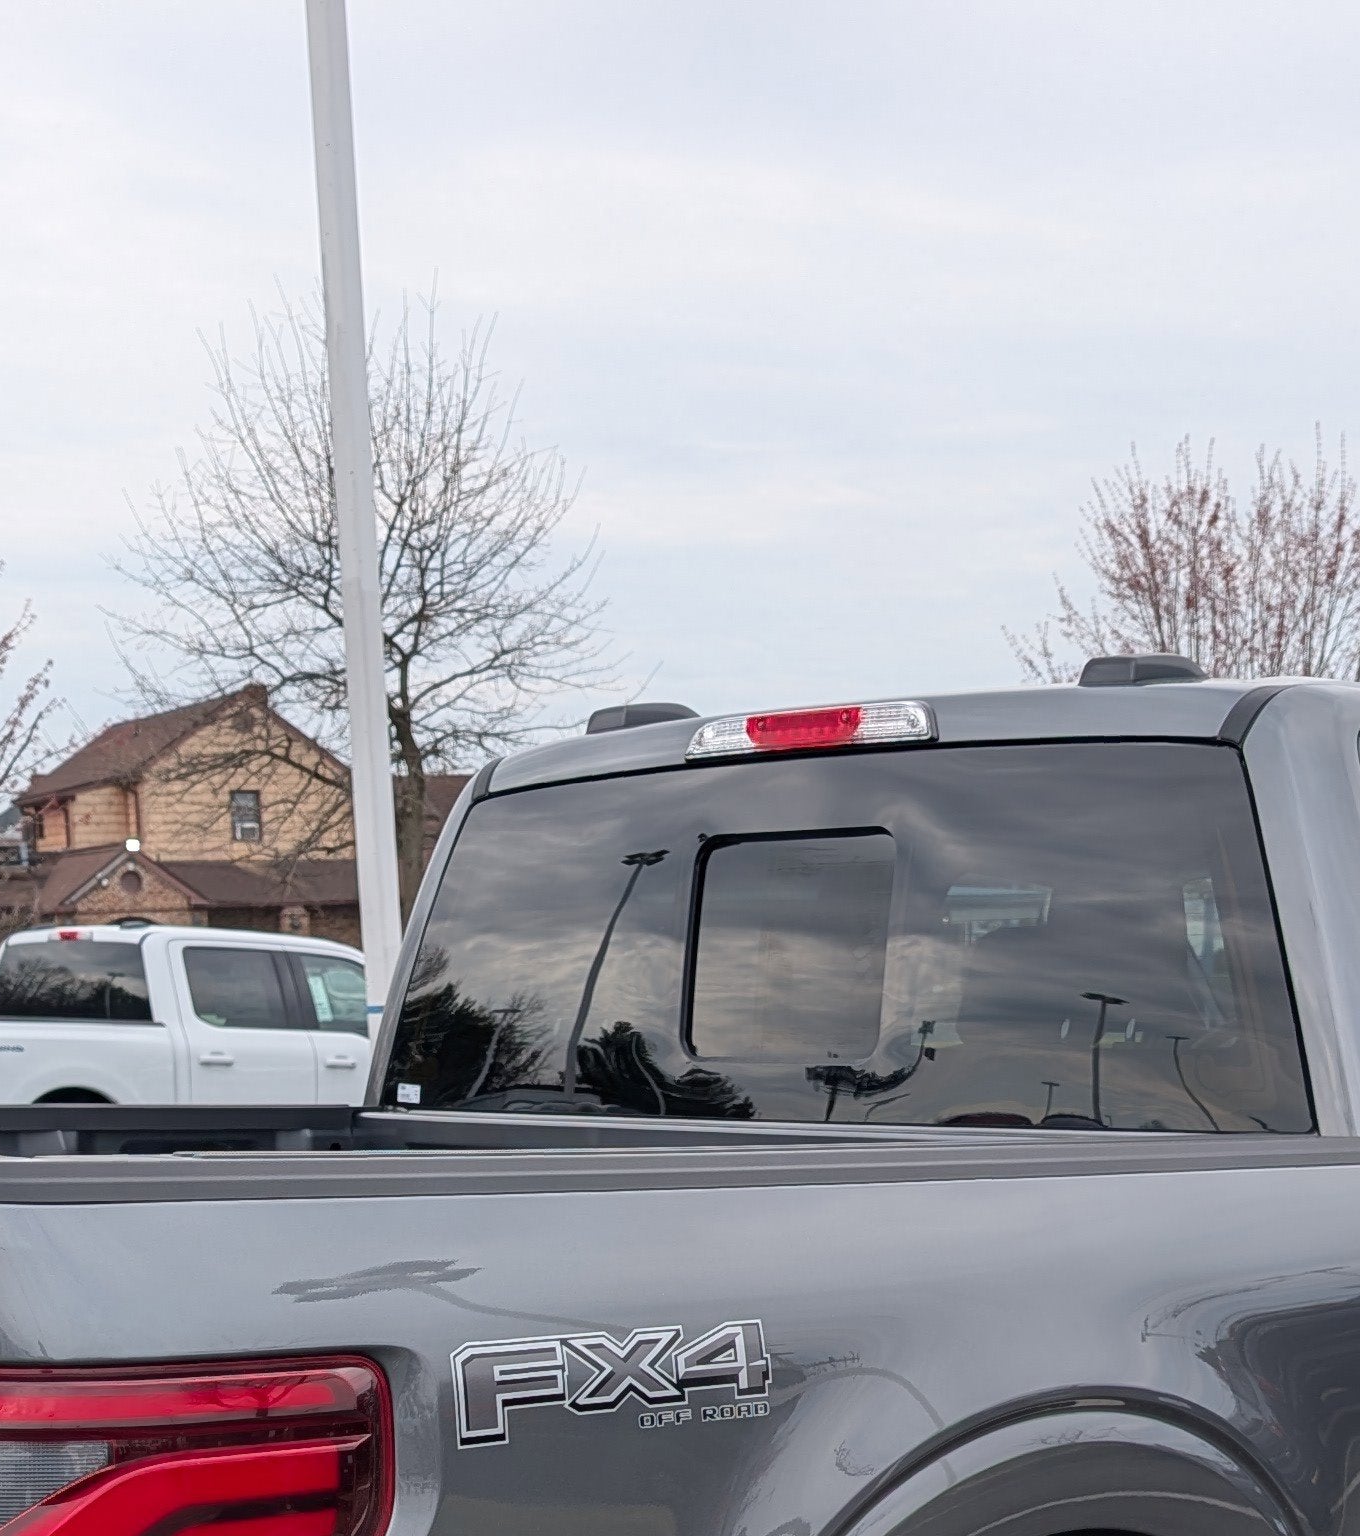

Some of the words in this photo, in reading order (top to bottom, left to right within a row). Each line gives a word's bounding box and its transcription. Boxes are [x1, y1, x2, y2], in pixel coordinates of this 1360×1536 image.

[450, 1319, 771, 1450] FX4
[639, 1408, 692, 1429] OFF
[701, 1401, 770, 1422] ROAD
